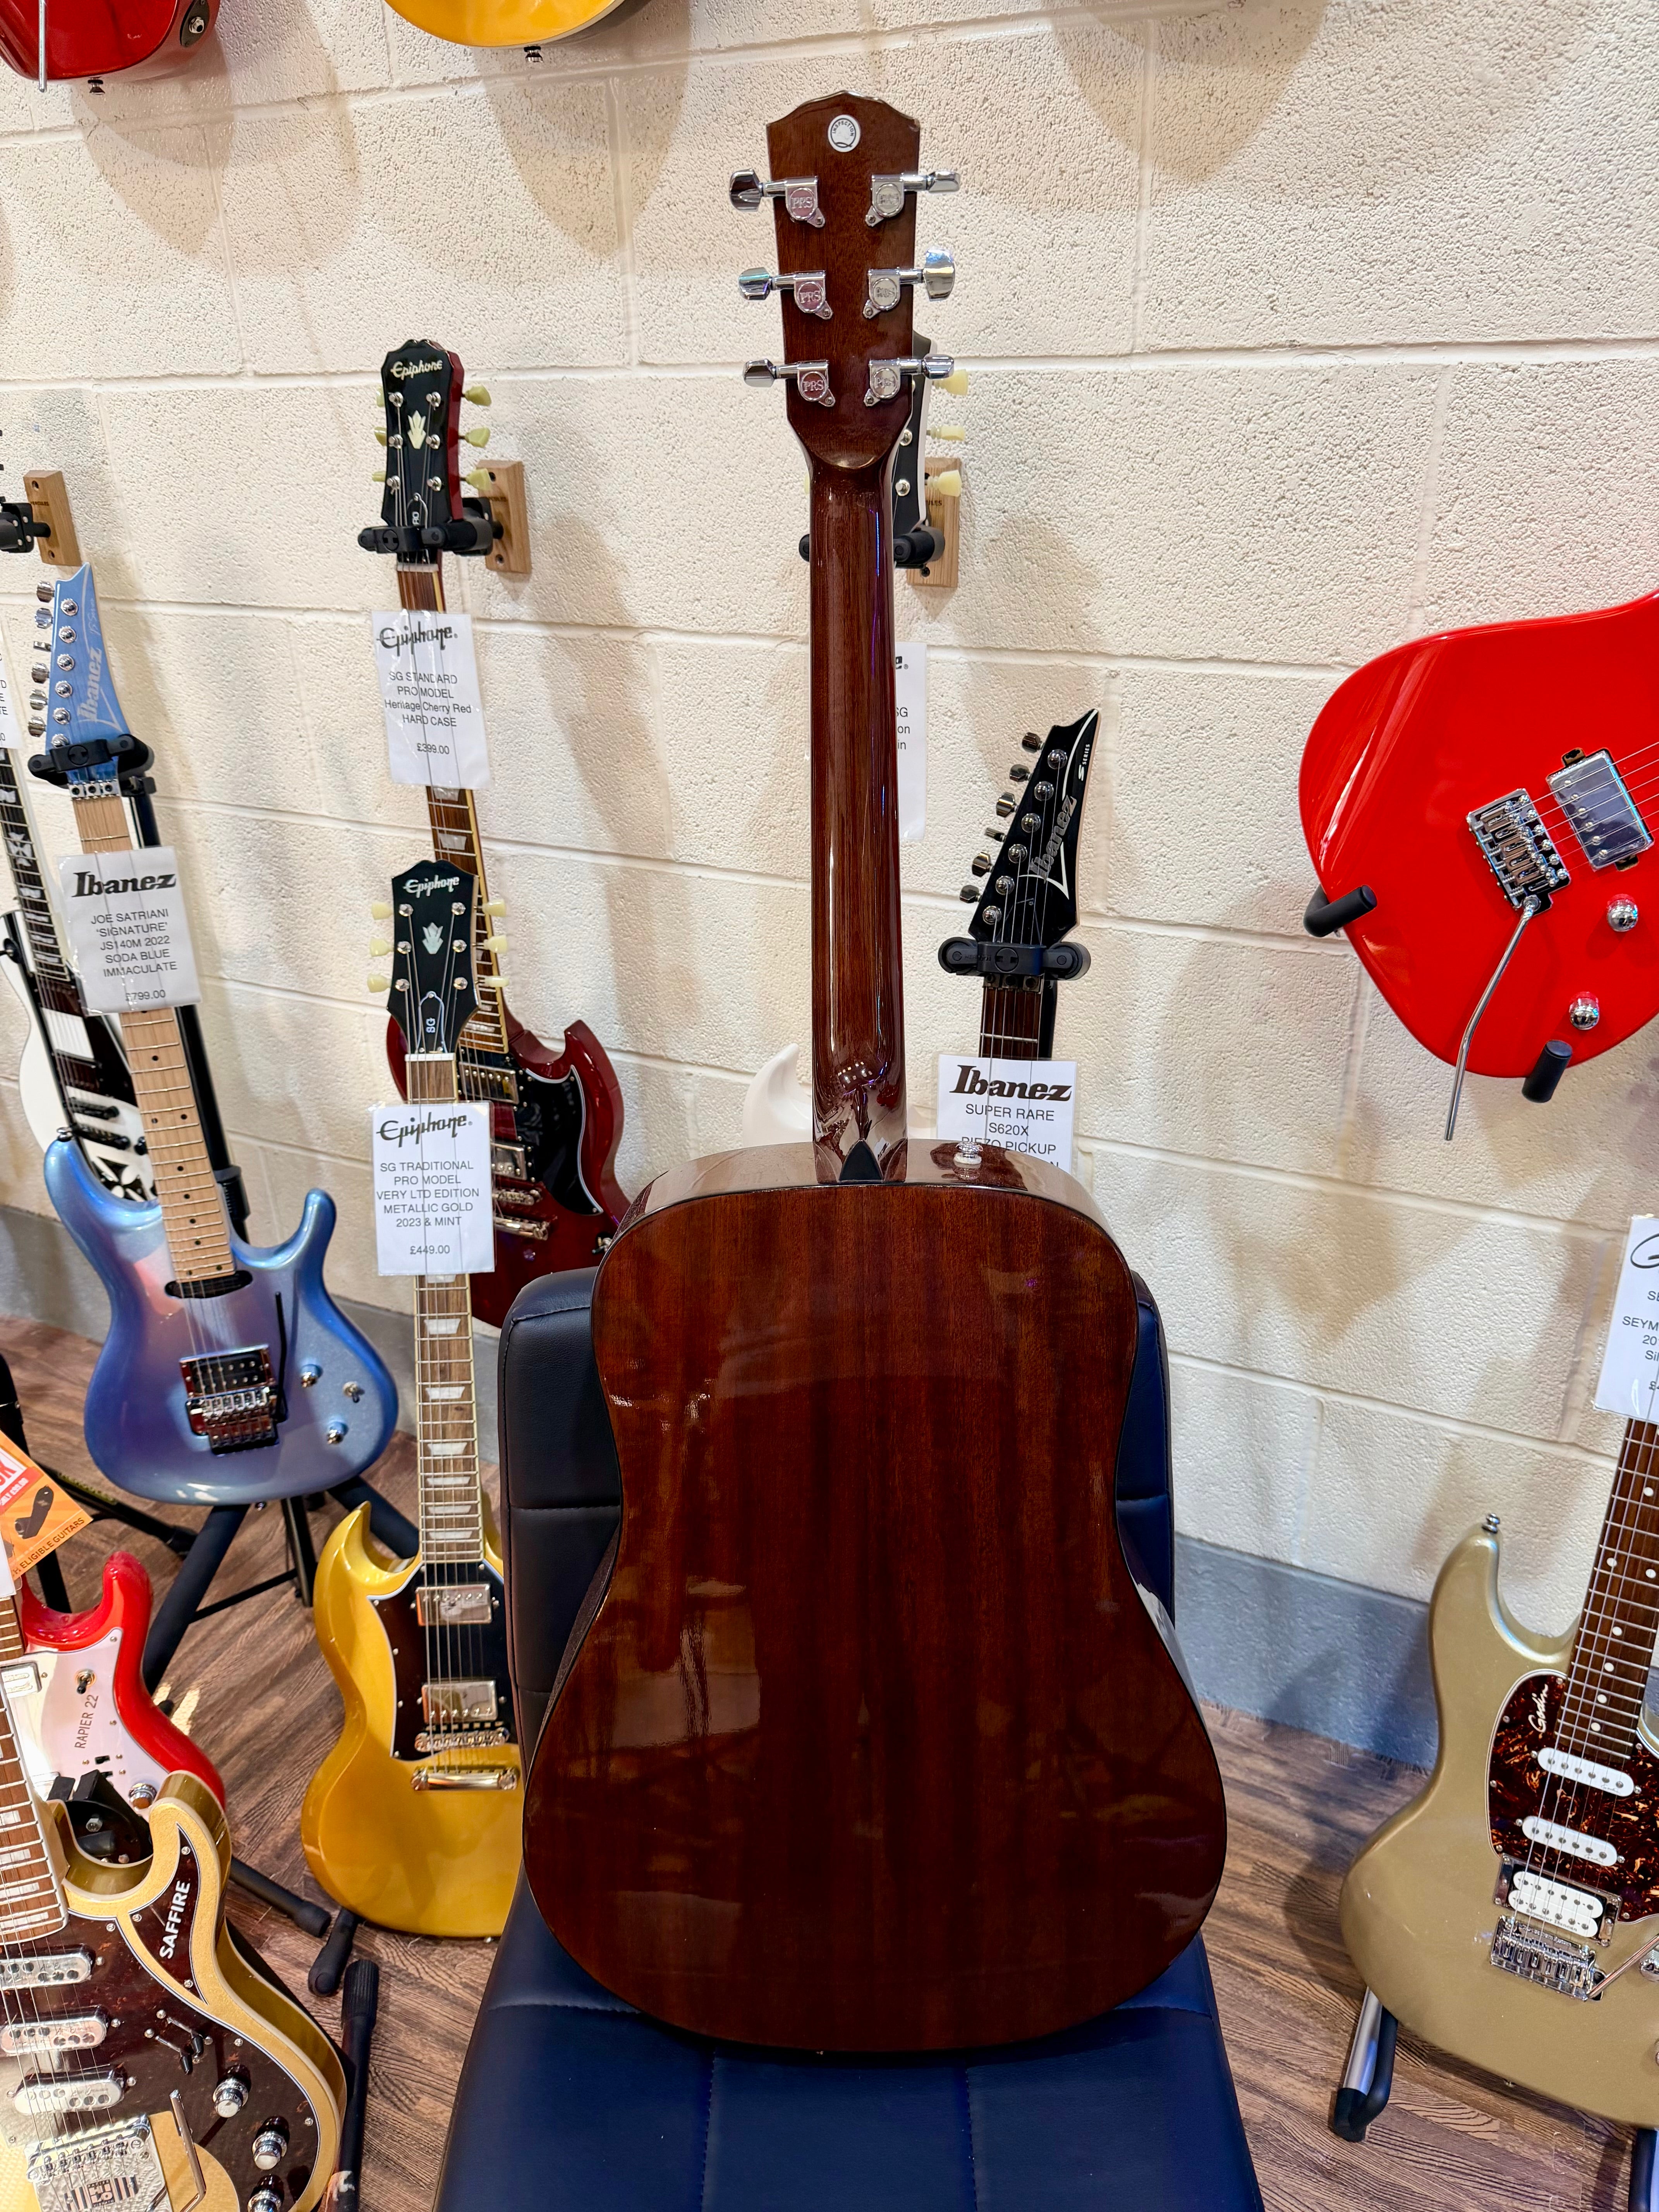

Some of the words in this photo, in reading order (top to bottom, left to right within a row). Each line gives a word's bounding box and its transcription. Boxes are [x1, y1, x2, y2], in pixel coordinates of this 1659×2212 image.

[832, 120, 854, 136] INSPECTION
[791, 197, 813, 209] PRS
[799, 290, 821, 304] PRS
[390, 359, 443, 381] Epiphone
[803, 380, 824, 392] PRS
[389, 672, 404, 681] SG
[77, 647, 102, 723] Ibanez
[397, 686, 418, 697] PRO
[421, 689, 454, 699] MODEL
[423, 702, 450, 714] Cherry
[453, 704, 472, 713] Red
[403, 715, 429, 725] HARD
[431, 717, 457, 727] CASE
[1082, 744, 1090, 765] SERIES
[1027, 795, 1077, 884] Ibanez
[71, 871, 177, 898] Ibanez
[403, 874, 460, 898] Epiphone
[91, 914, 112, 925] JOE
[116, 908, 169, 922] SATRIANI
[145, 936, 171, 947] 2022
[105, 953, 138, 963] SODA
[141, 949, 170, 960] BLUE
[103, 961, 178, 977] IMMACULATE
[949, 1065, 1072, 1101] Ibanez
[965, 1104, 1012, 1118] SUPER
[1016, 1108, 1054, 1121] RARE
[376, 1111, 468, 1148] Epiphone
[989, 1122, 1029, 1136] S620X
[1006, 1141, 1056, 1155] PICKUP
[380, 1163, 397, 1172] SG
[400, 1160, 474, 1171] TRADITIONAL
[394, 1176, 418, 1185] PRO
[422, 1175, 461, 1185] MODEL
[376, 1190, 407, 1200] VERY
[410, 1189, 431, 1199] LTD
[434, 1188, 479, 1198] EDITION
[384, 1203, 438, 1214] METALLIC
[441, 1202, 473, 1212] GOLD
[396, 1217, 421, 1228] 2023
[424, 1217, 432, 1227] &
[435, 1216, 462, 1226] MINT
[410, 1245, 450, 1255] £449.00
[19, 1540, 55, 1569] ELIGIBLE
[53, 1517, 85, 1543] GUITARS
[1528, 1683, 1549, 1733] Godin
[74, 1712, 94, 1749] RAPIER
[84, 1695, 99, 1709] 22
[159, 1880, 191, 1960] SAFFIRE
